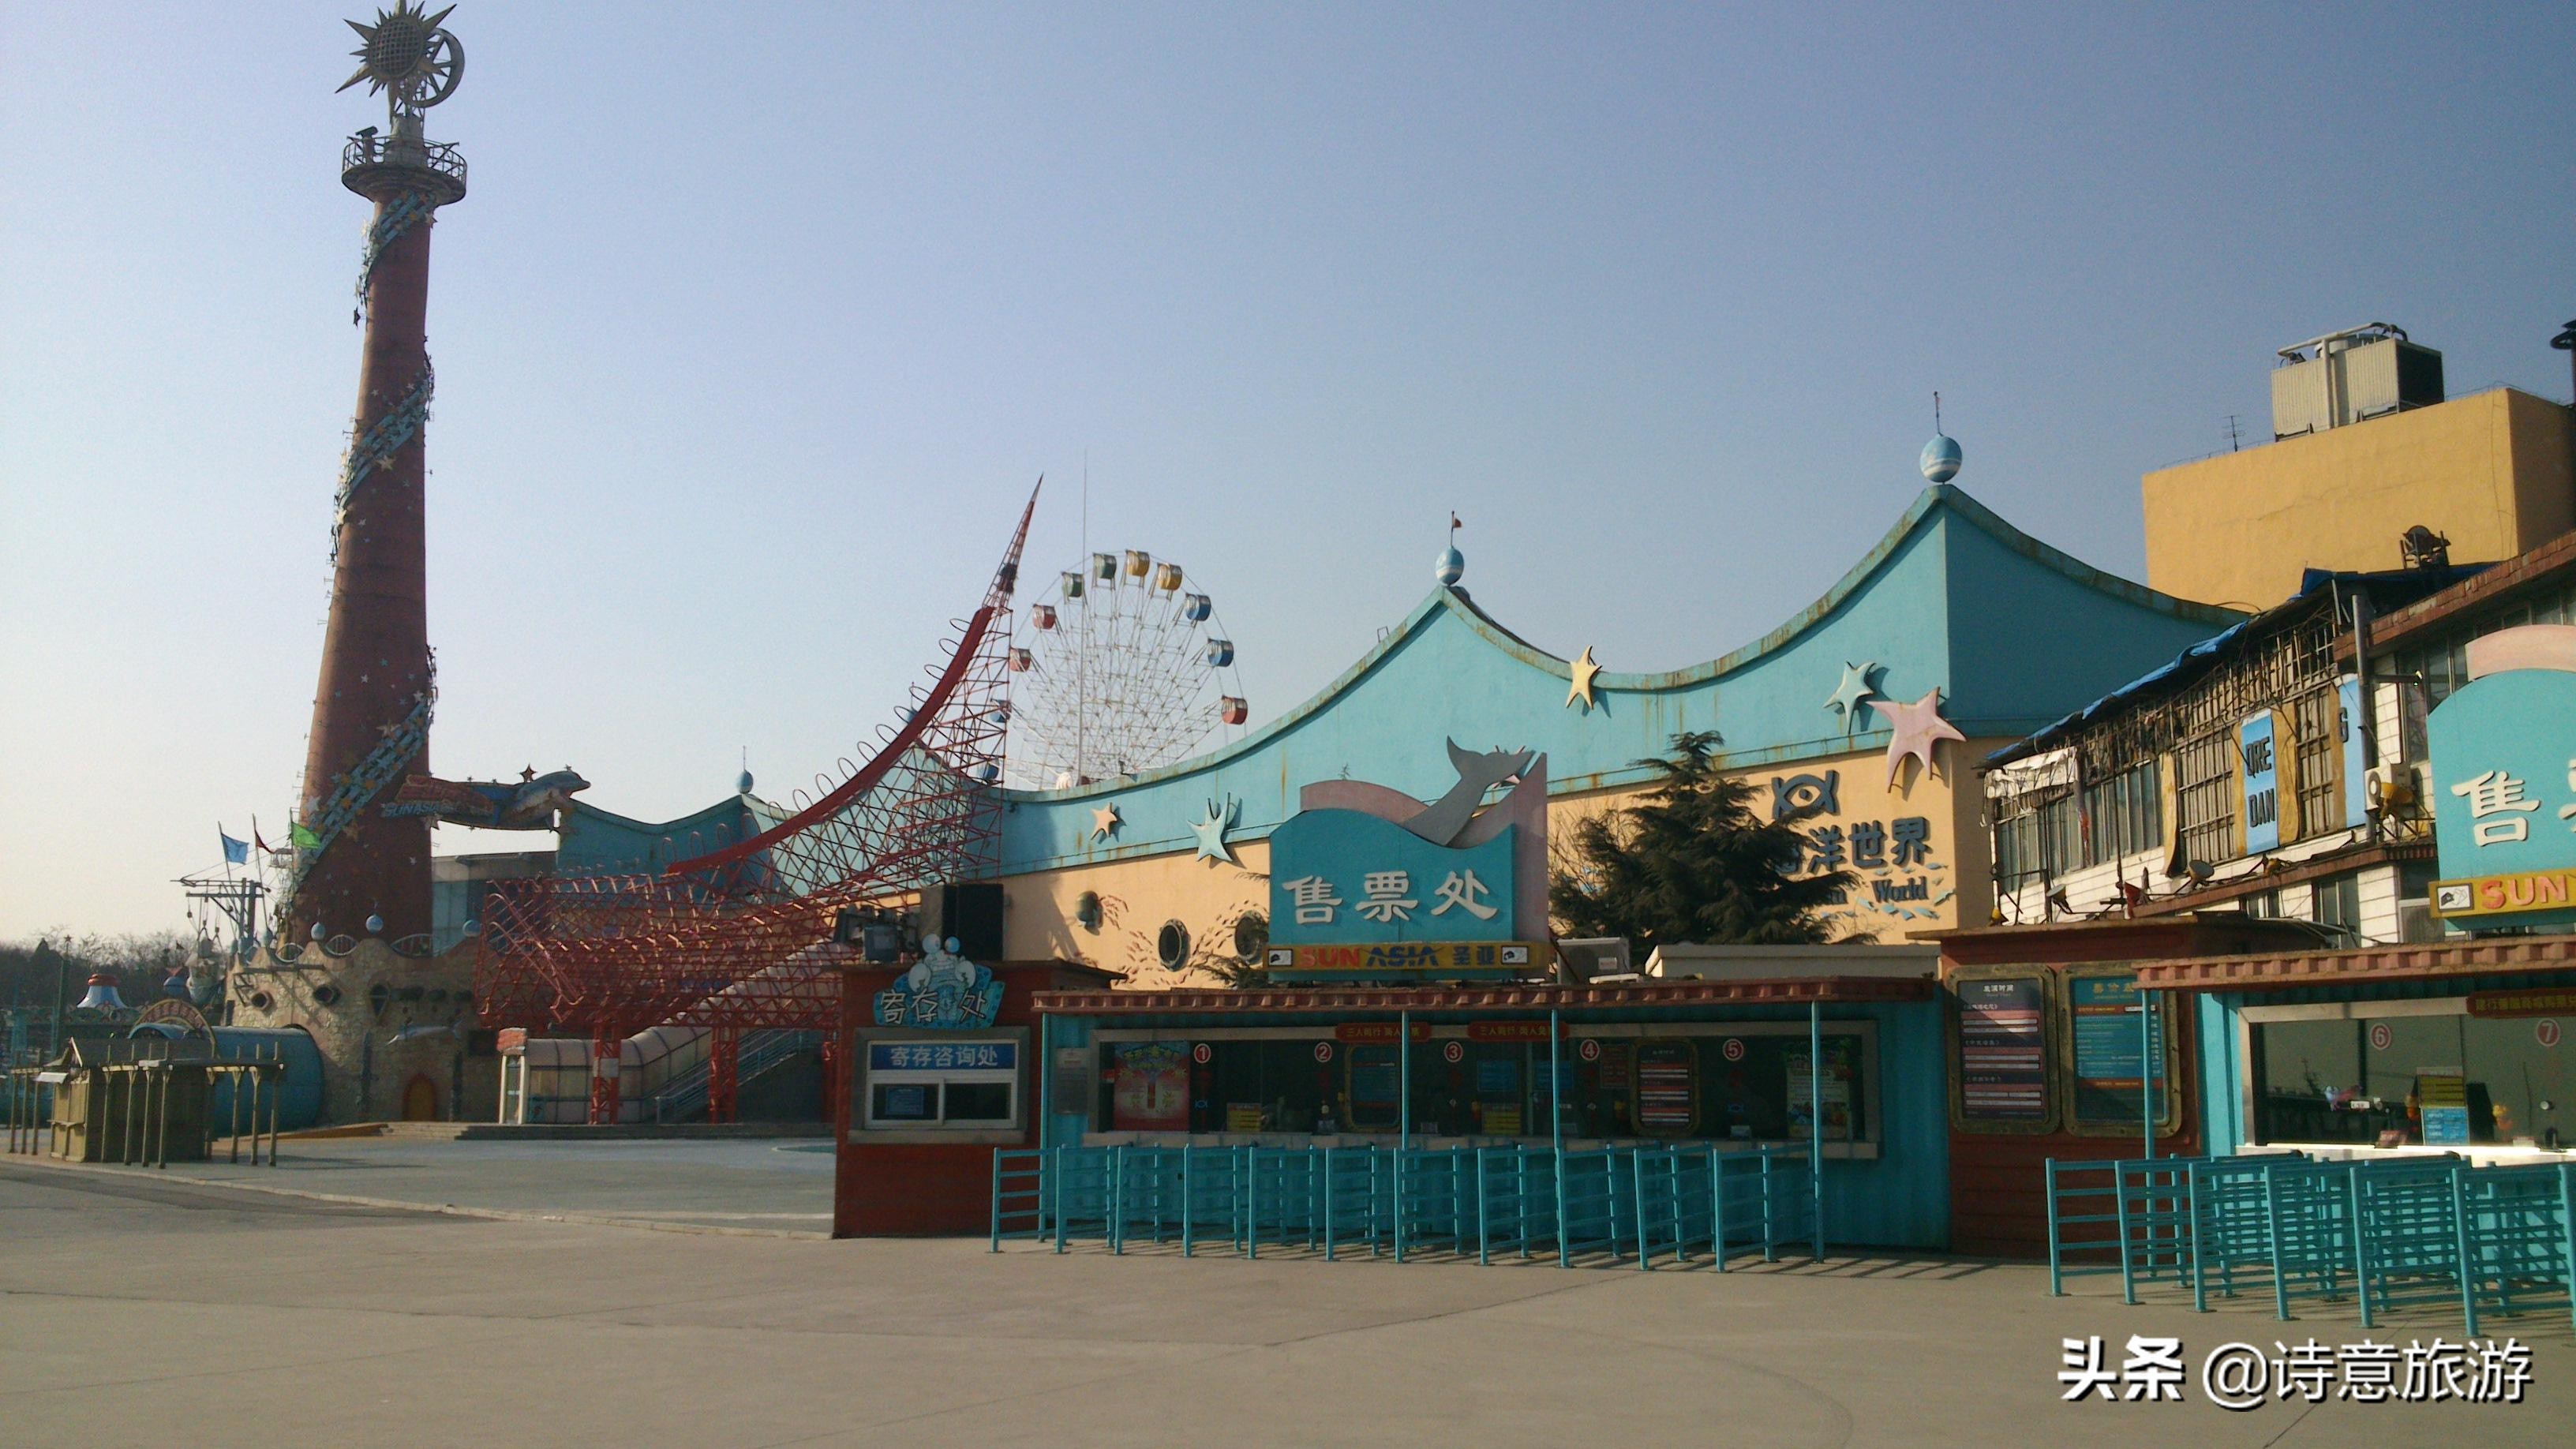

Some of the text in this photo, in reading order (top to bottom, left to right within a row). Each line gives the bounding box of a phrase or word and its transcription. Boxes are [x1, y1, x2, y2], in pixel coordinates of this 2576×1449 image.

[2248, 788, 2275, 828] DAN
[2451, 769, 2576, 848] 售
[1282, 868, 1500, 926] 售票处
[1871, 875, 1930, 904] World
[2481, 874, 2567, 910] SUN
[1299, 945, 1496, 968] SUN ASIA 圣亚
[880, 988, 987, 1024] 寄存处
[890, 1046, 998, 1067] 寄存咨询处
